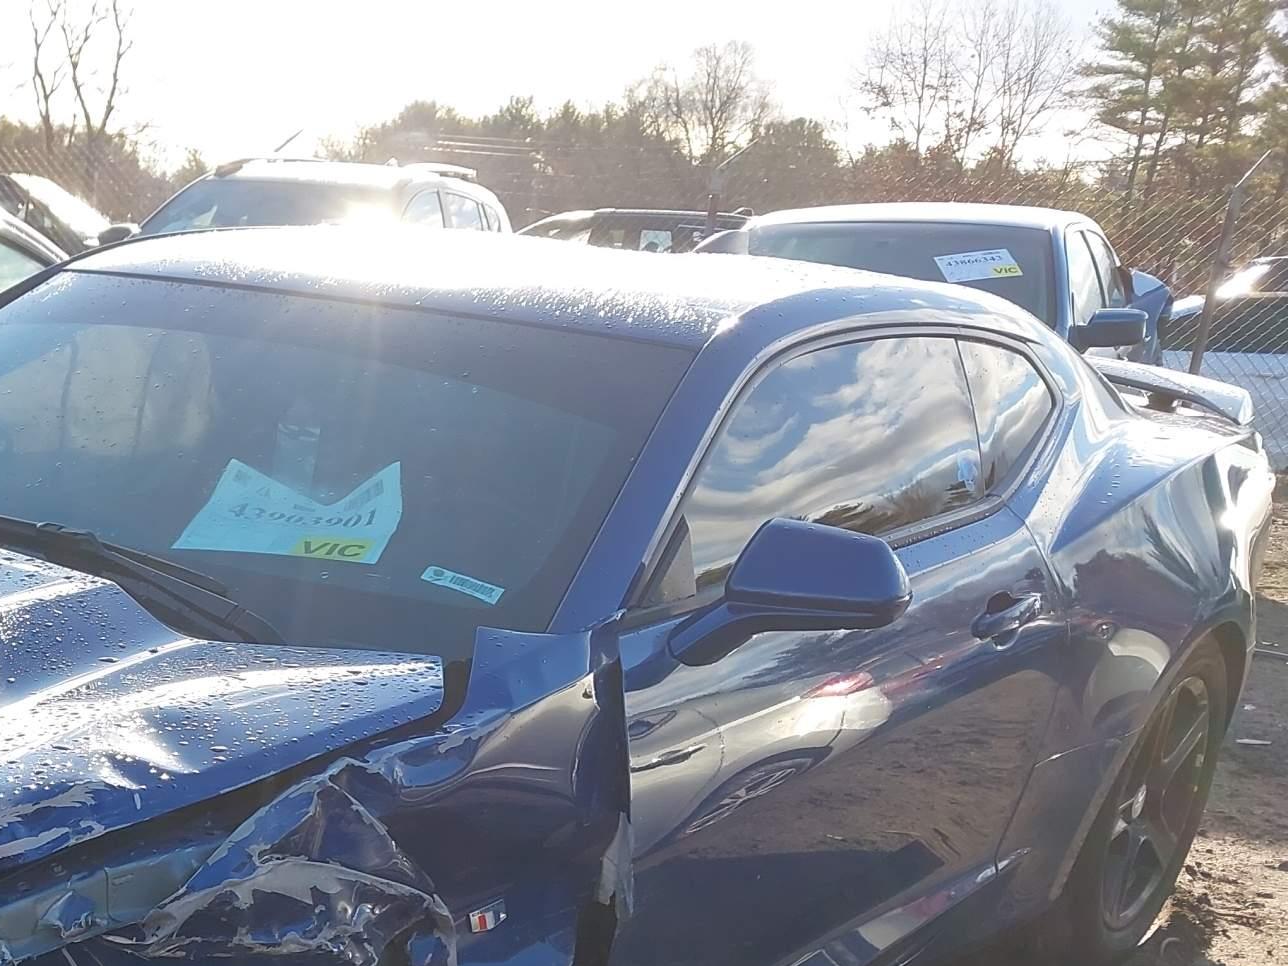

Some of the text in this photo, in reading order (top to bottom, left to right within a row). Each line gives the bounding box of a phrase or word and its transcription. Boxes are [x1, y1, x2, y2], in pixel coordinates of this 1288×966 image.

[993, 266, 1019, 274] VIC
[228, 503, 377, 529] 43903901
[304, 541, 366, 557] VIC
